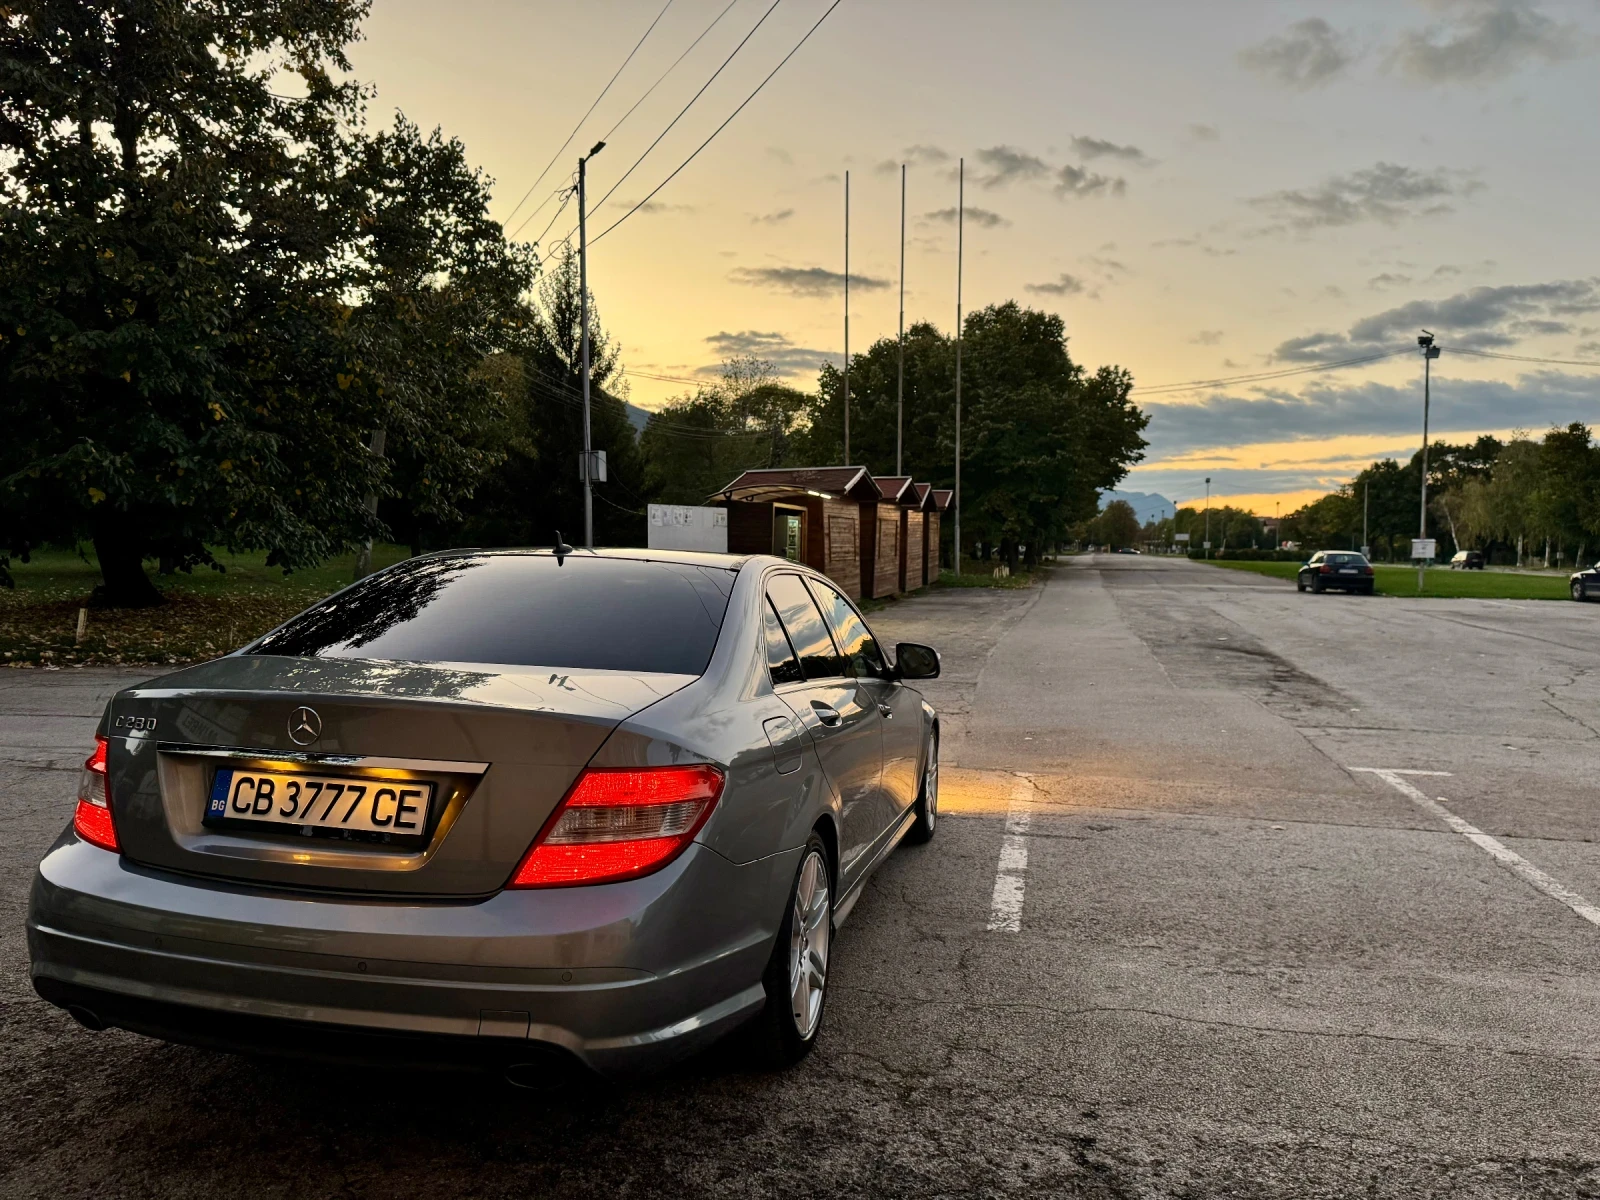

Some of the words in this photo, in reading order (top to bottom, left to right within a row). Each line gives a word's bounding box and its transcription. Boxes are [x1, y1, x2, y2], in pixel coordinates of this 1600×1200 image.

[211, 799, 226, 811] BG
[232, 777, 276, 815] CB
[280, 780, 367, 823] 3777
[370, 788, 422, 829] CE
